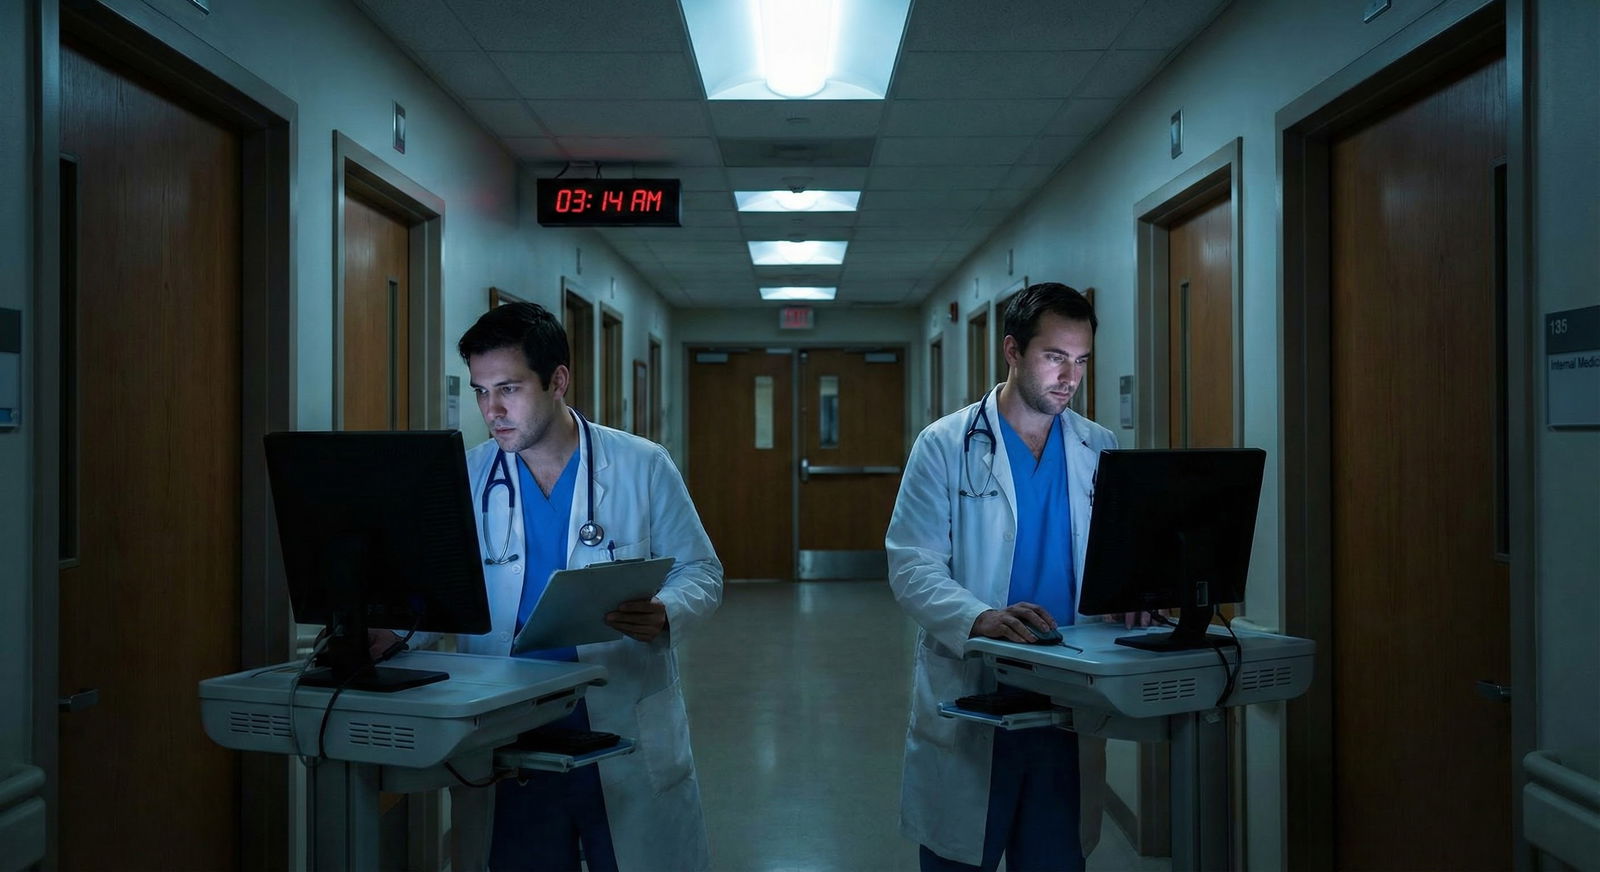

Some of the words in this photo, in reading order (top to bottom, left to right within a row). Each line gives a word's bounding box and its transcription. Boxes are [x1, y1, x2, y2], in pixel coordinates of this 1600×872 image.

[630, 189, 662, 212] AM
[1550, 318, 1568, 335] 135
[1551, 358, 1576, 370] Internal
